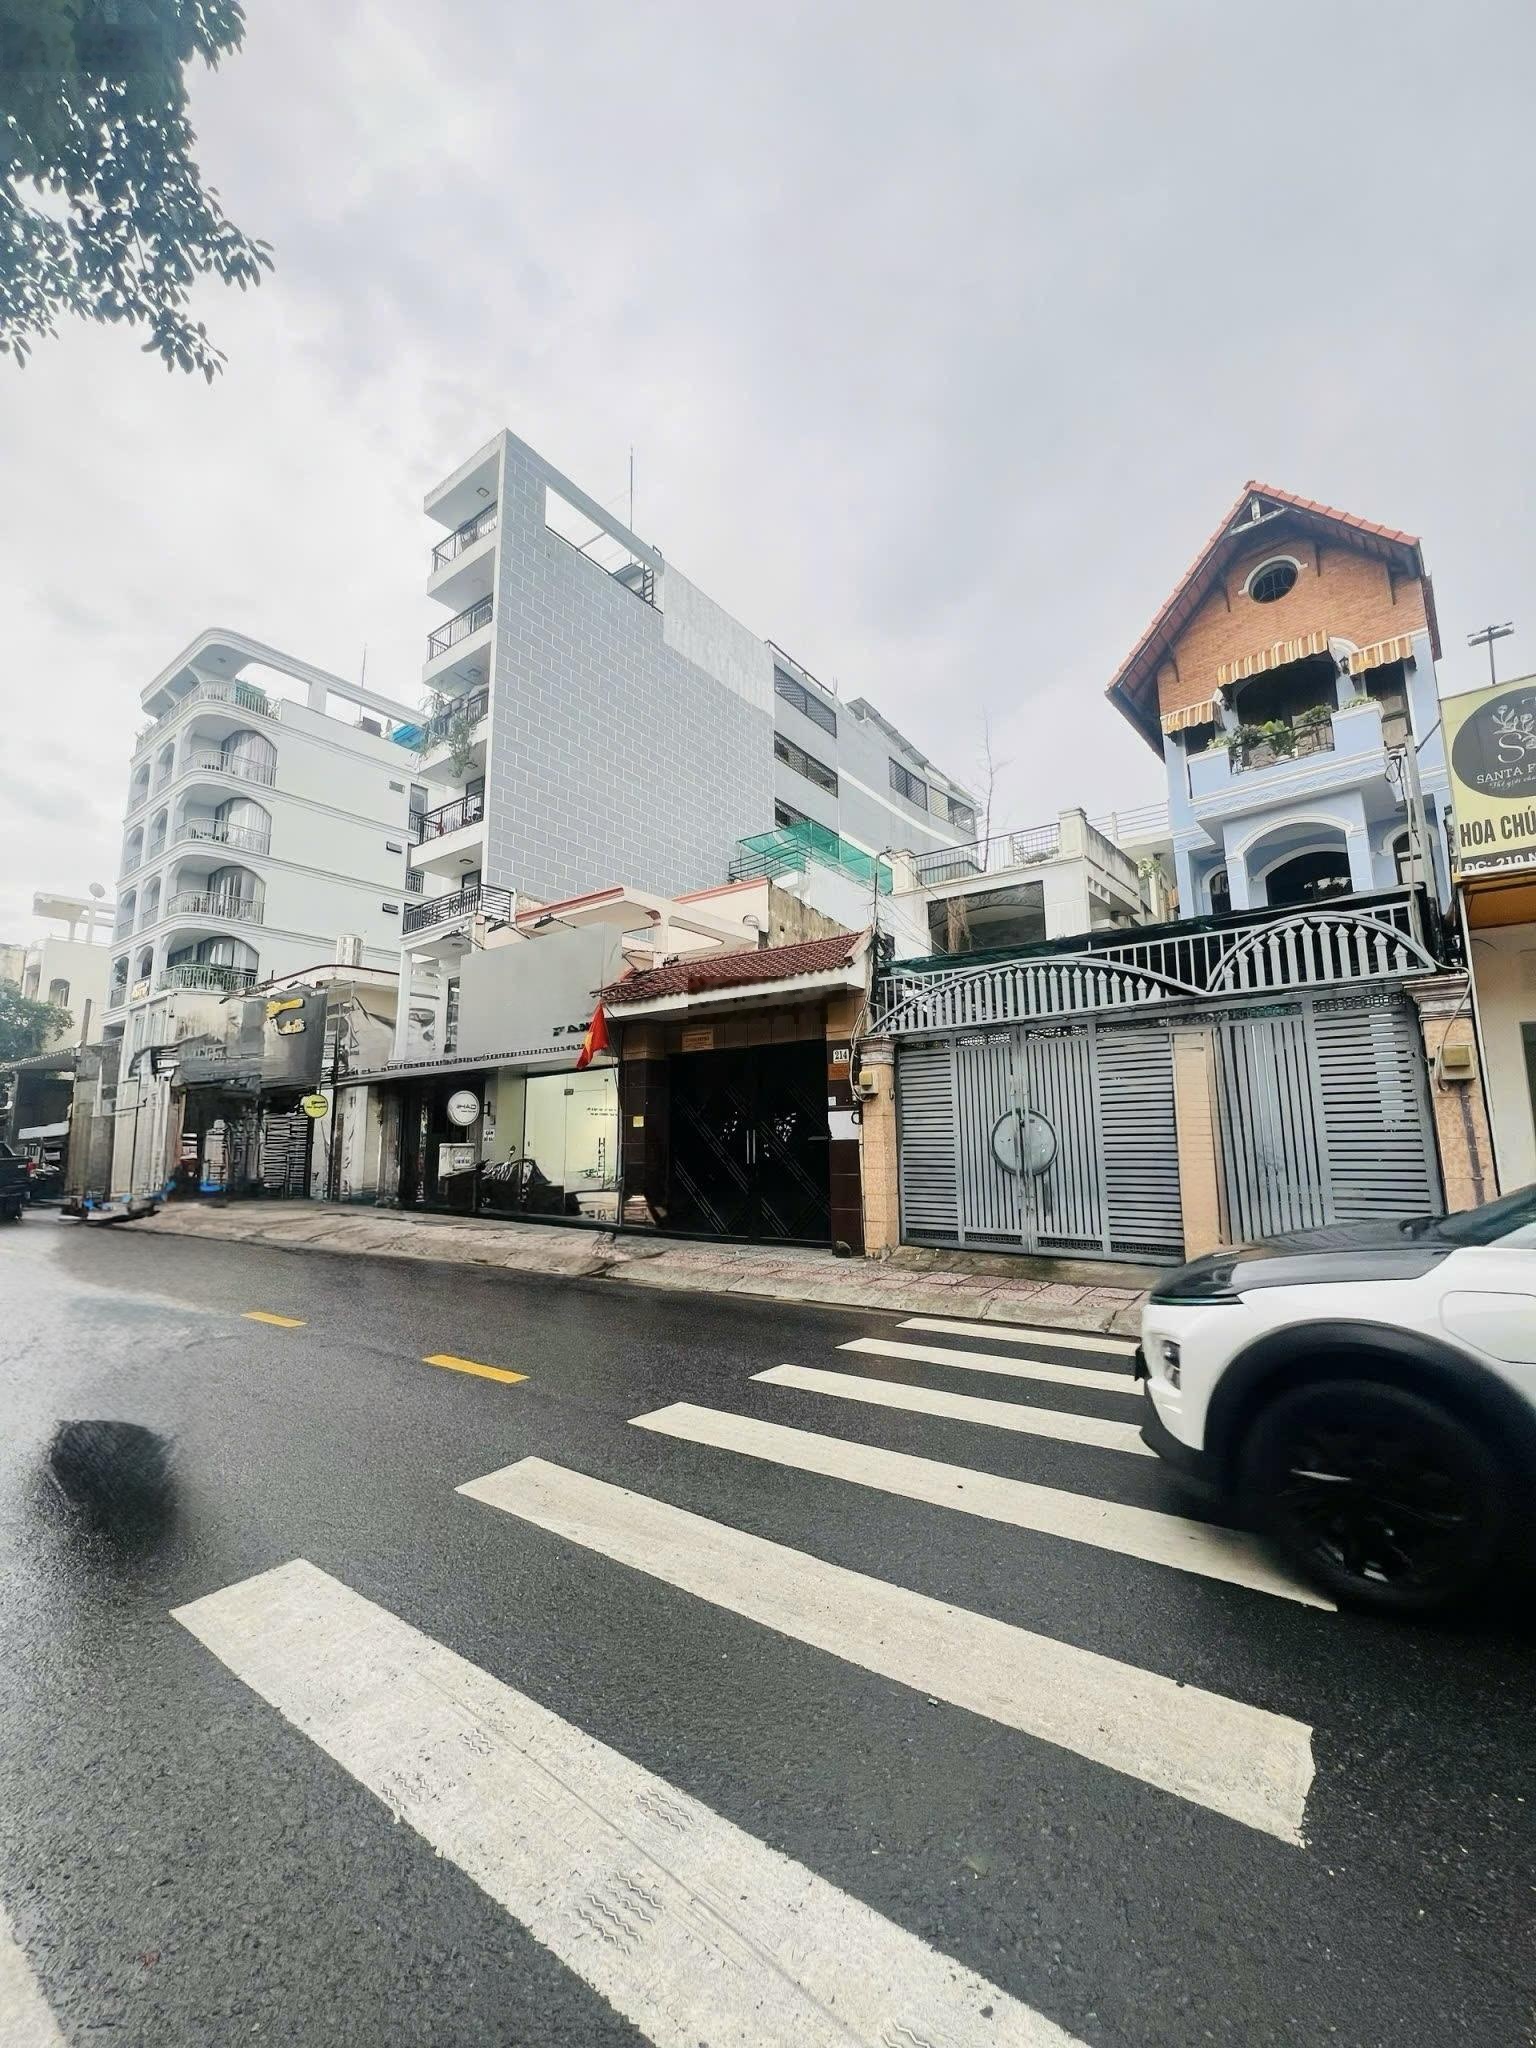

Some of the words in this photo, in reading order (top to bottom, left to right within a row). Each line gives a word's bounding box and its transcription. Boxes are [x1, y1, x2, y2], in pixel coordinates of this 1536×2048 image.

[1476, 767, 1523, 784] SANTA
[1460, 819, 1496, 847] HOA
[1500, 805, 1536, 839] CHÚ
[835, 1051, 848, 1060] 214
